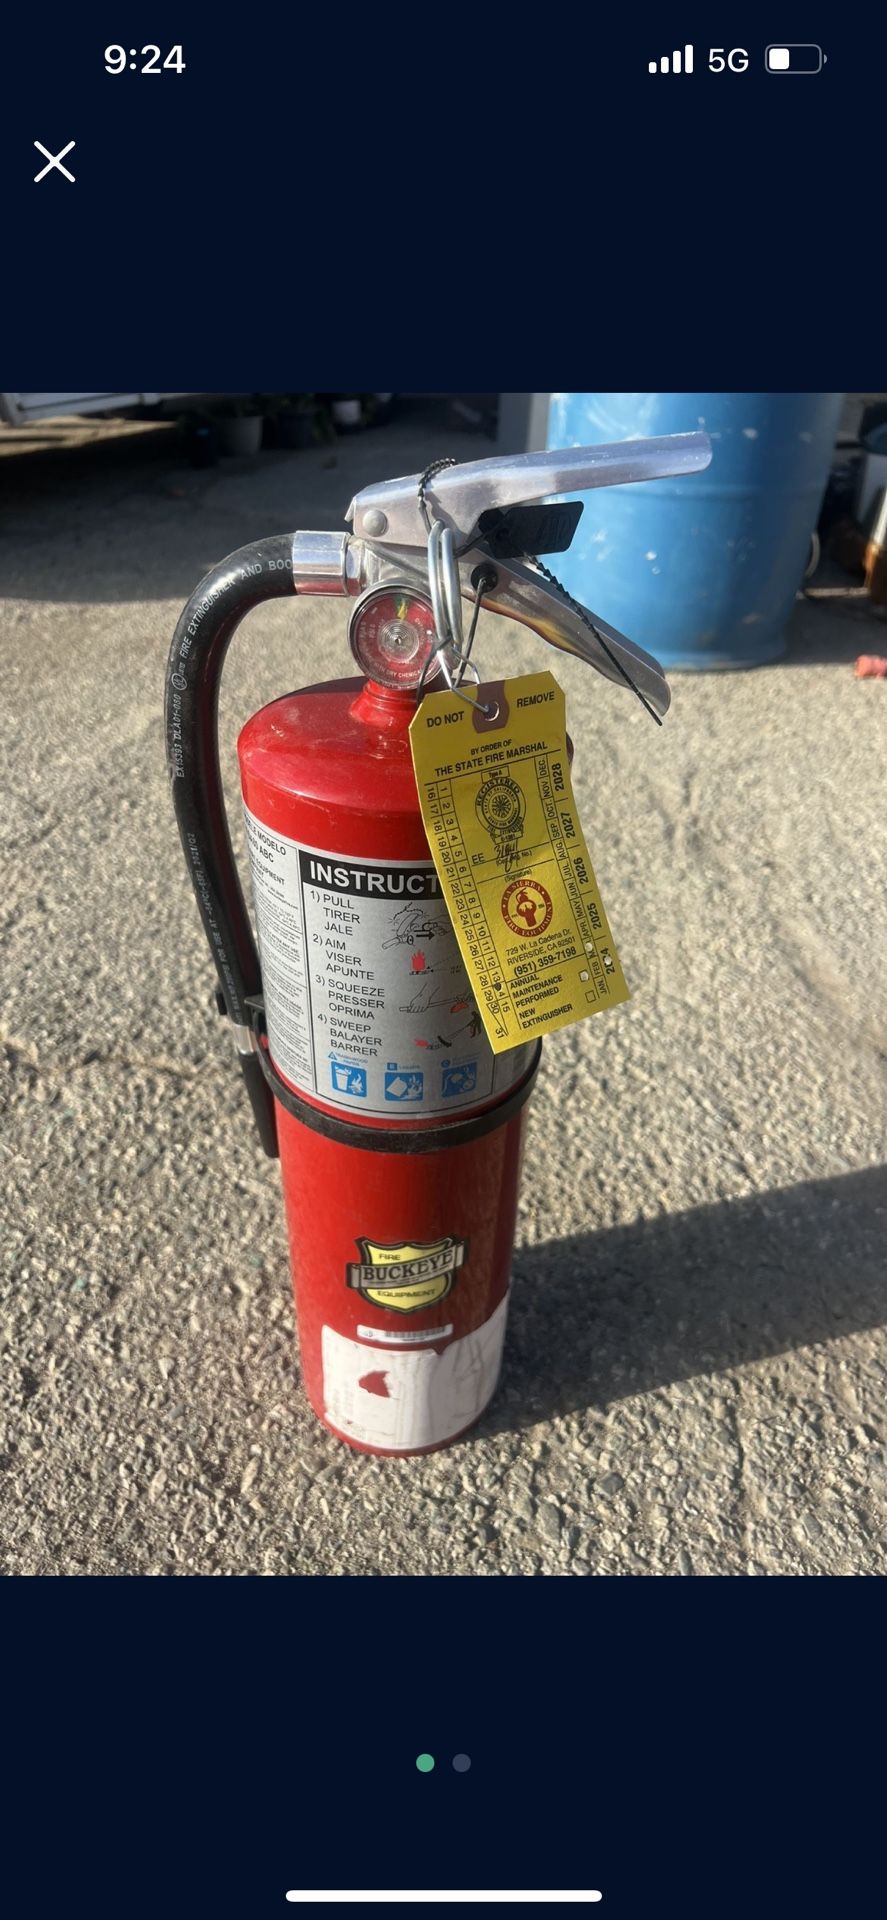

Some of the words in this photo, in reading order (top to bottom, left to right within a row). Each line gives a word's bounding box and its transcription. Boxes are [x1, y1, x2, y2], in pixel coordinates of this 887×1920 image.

[180, 636, 192, 659] FIRE
[187, 577, 236, 636] EXTINGUISHER
[240, 563, 263, 579] AND
[516, 691, 555, 708] REMOVE
[426, 716, 442, 728] DO
[443, 711, 465, 724] NOT
[471, 747, 480, 755] BY
[480, 741, 502, 754] ORDER
[503, 739, 513, 749] OF
[435, 765, 453, 777] THE
[456, 758, 483, 773] STATE
[485, 751, 505, 765] FIRE
[506, 741, 548, 761] MARSHAL
[551, 763, 564, 791] 2028
[427, 787, 436, 799] 16
[476, 778, 520, 807] REGISTERED
[430, 807, 439, 819] 17
[432, 821, 442, 832] 18
[561, 812, 575, 838] 2027
[257, 831, 286, 855] MODELO
[437, 836, 446, 847] 19
[260, 846, 274, 863] ABC
[441, 852, 451, 863] 20
[472, 853, 485, 864] EE
[446, 867, 456, 877] 21
[574, 857, 588, 884] 2026
[450, 884, 461, 895] 22
[511, 880, 541, 892] SIERRA
[310, 890, 320, 903] 1)
[323, 893, 355, 910] PULL
[455, 900, 465, 910] 23
[323, 907, 361, 925] TIRER
[573, 900, 584, 917] MAY
[587, 902, 602, 930] 2025
[460, 914, 470, 926] 24
[324, 921, 353, 937] JALE
[464, 929, 475, 941] 25
[476, 925, 487, 937] 10
[312, 933, 323, 946] 2)
[325, 938, 347, 951] AIM
[469, 944, 480, 956] 26
[481, 941, 491, 952] 11
[326, 950, 362, 966] VISER
[487, 956, 497, 967] 12
[507, 947, 547, 966] RIVERSIDE,
[547, 942, 558, 951] CA
[514, 959, 537, 977] (951)
[538, 947, 577, 968] 359-7198
[326, 963, 375, 981] APUNTE
[474, 959, 484, 971] 27
[479, 975, 489, 986] 28
[492, 971, 501, 982] 13
[509, 973, 540, 990] ANNUAL
[315, 974, 326, 987] 3)
[328, 978, 385, 998] SQUEEZE
[512, 974, 563, 999] MAINTENANCE
[328, 990, 385, 1009] PRESSER
[484, 990, 494, 1001] 29
[515, 986, 560, 1008] PERFORMED
[328, 1002, 375, 1020] OPRIMA
[490, 1003, 499, 1013] 30
[501, 1002, 510, 1013] 15
[519, 1007, 536, 1020] NEW
[317, 1014, 327, 1027] 4)
[330, 1017, 371, 1033] SWEEP
[521, 1003, 573, 1029] EXTINGUISHER
[330, 1028, 382, 1046] BALAYER
[494, 1027, 505, 1039] 31
[330, 1039, 378, 1057] BARRER
[363, 1249, 453, 1281] BUCKEYE
[378, 1253, 401, 1261] FIRE
[377, 1289, 435, 1298] EQUIPMENT
